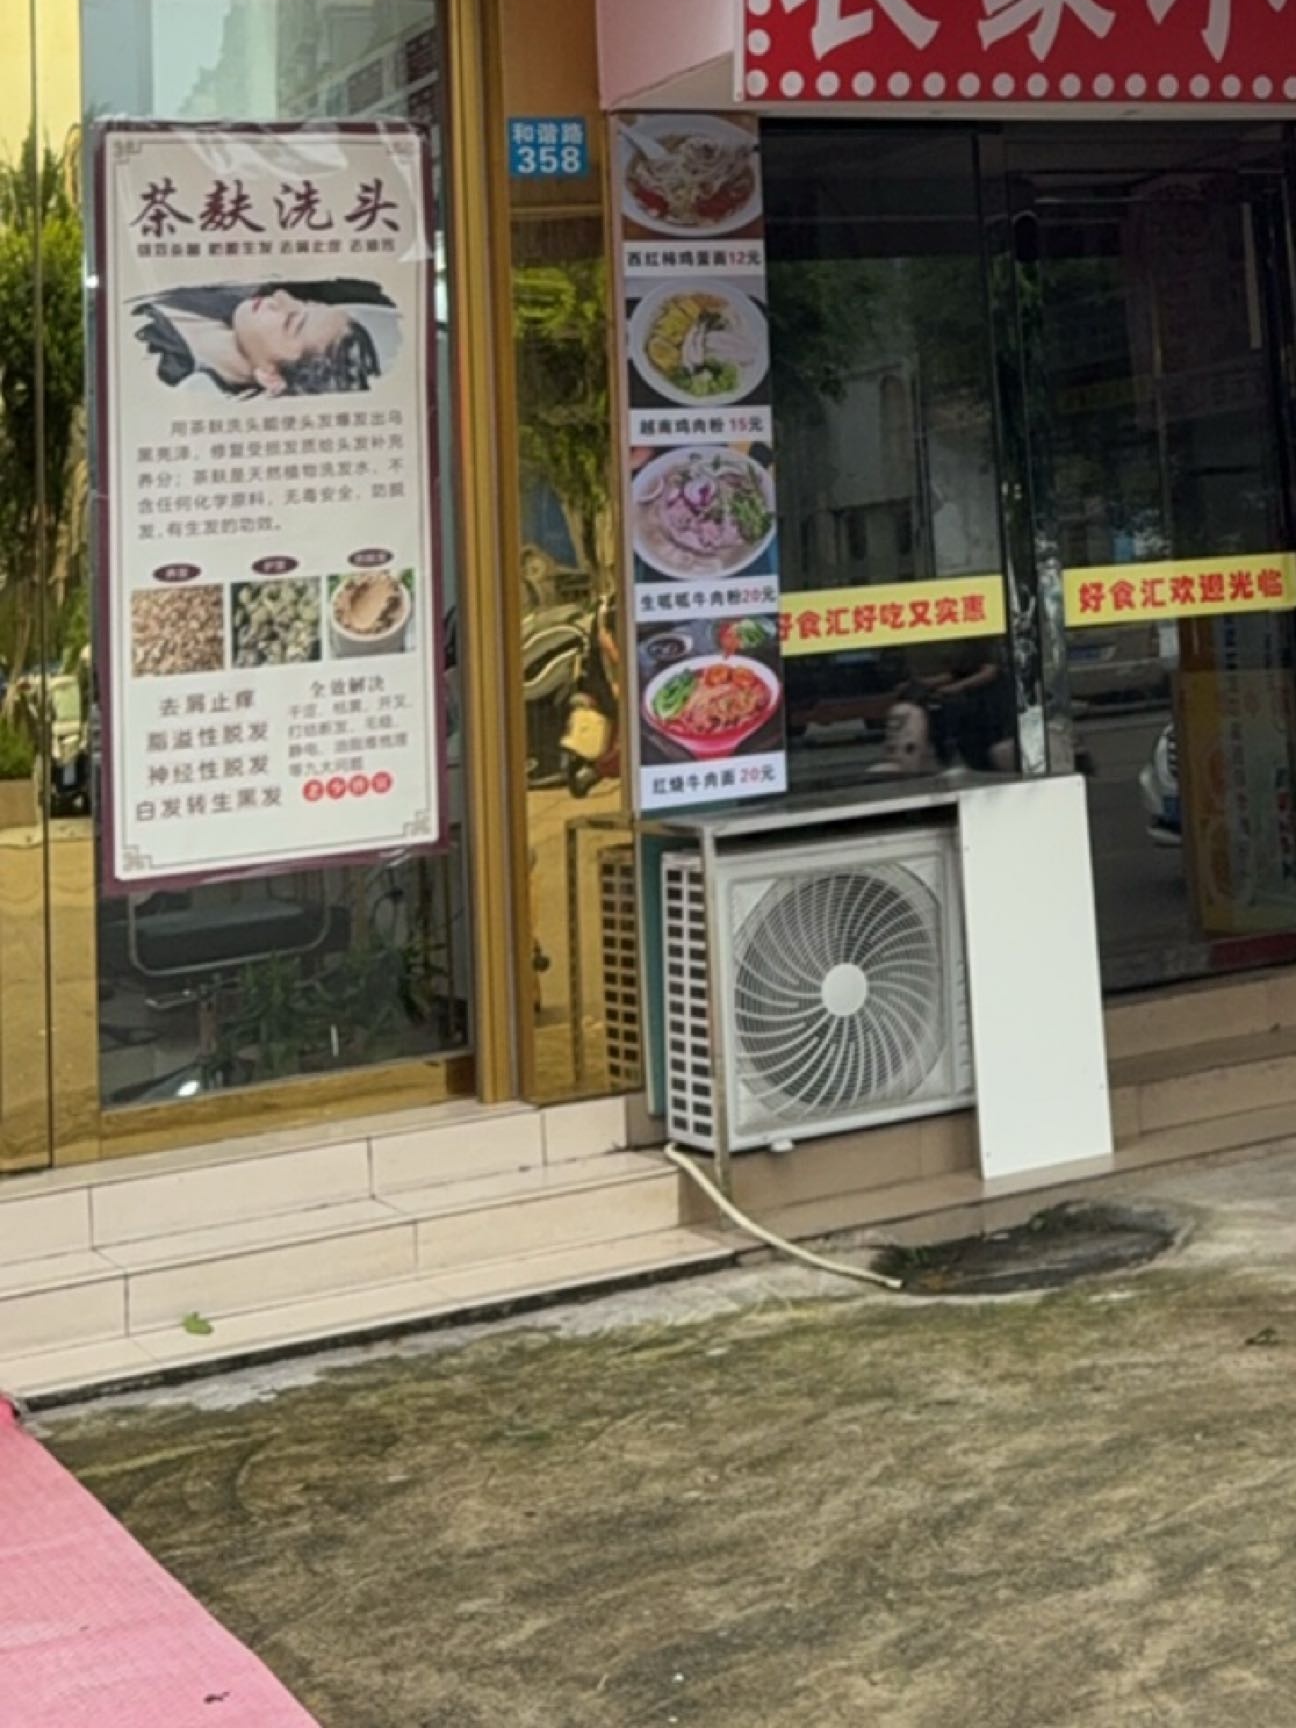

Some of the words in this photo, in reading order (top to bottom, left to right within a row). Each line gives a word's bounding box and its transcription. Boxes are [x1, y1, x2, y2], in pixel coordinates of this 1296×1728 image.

[518, 147, 582, 174] 358
[131, 177, 400, 238] 茶麸洗头
[1078, 568, 1284, 614] 好食汇欢迎光临
[740, 765, 776, 784] 20元
